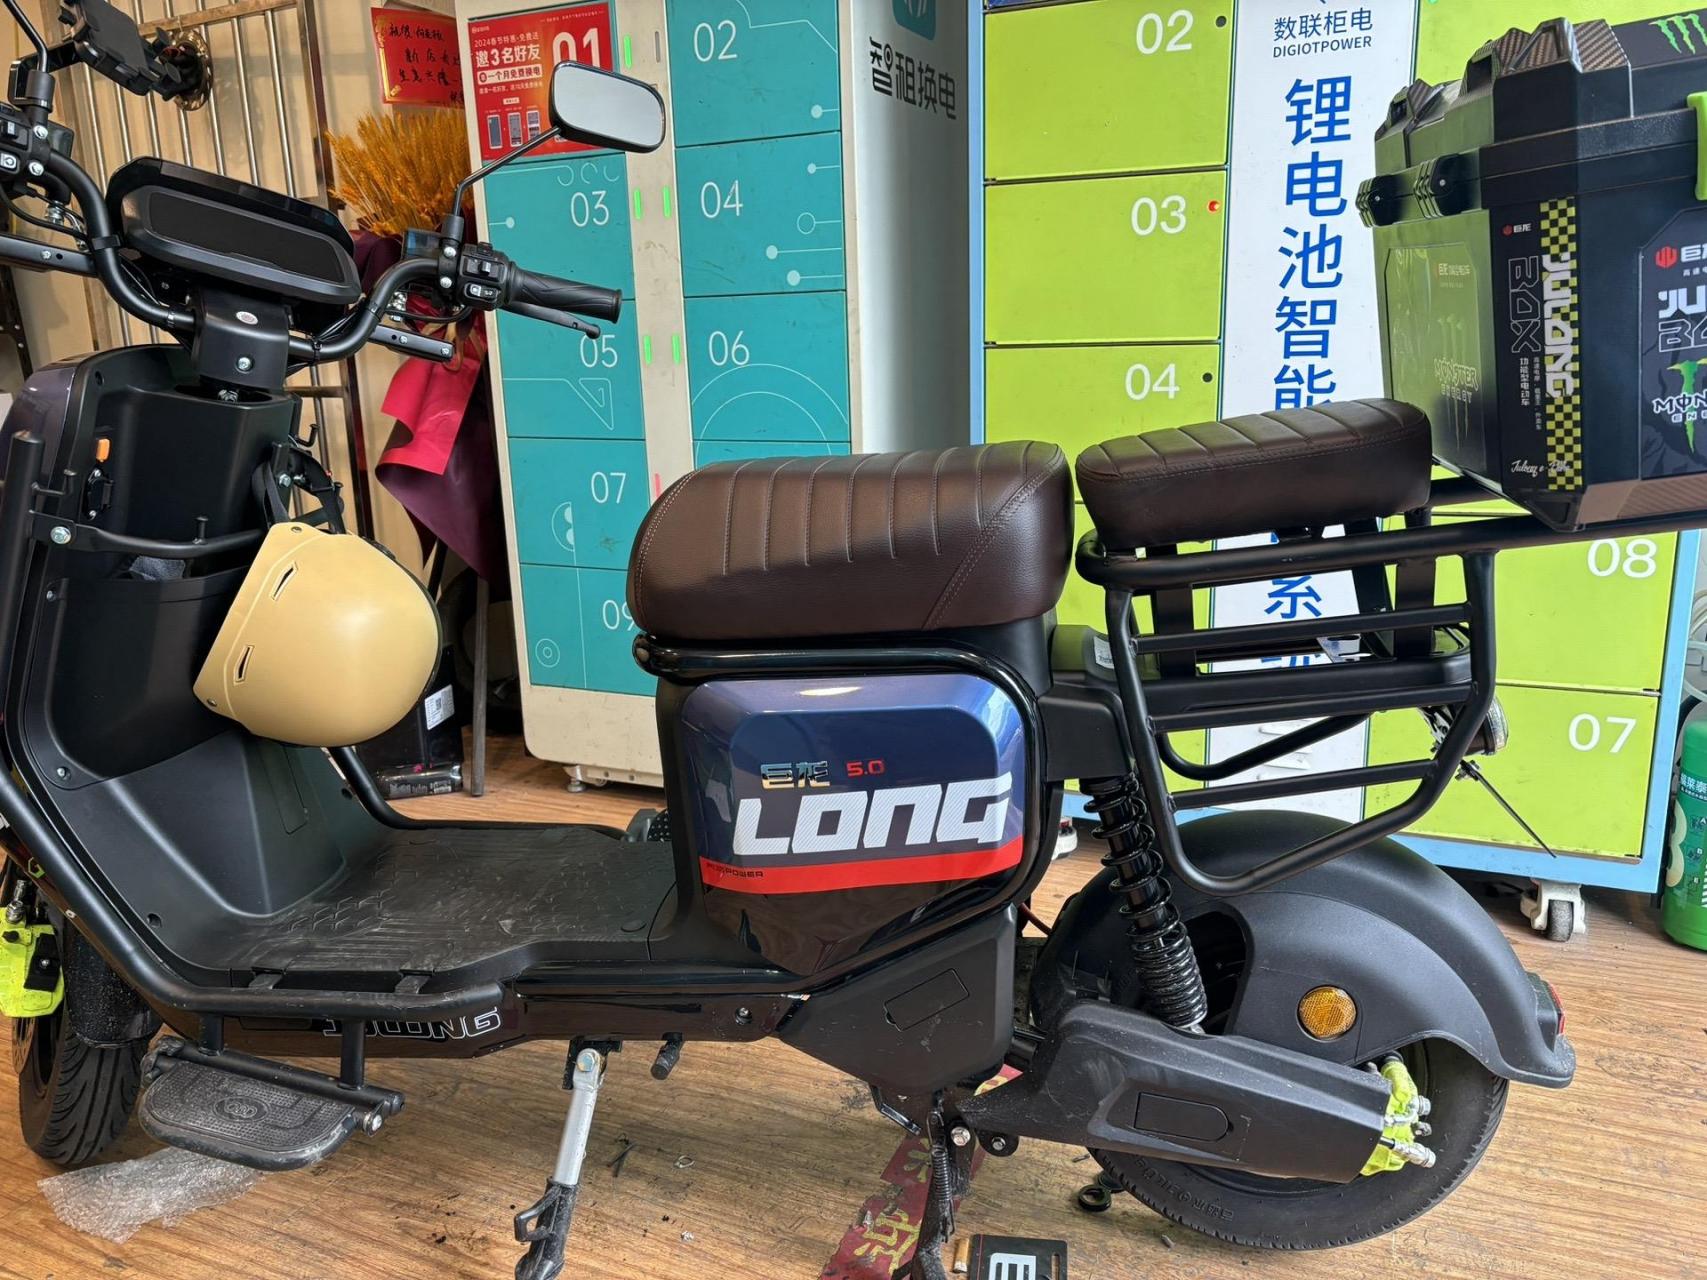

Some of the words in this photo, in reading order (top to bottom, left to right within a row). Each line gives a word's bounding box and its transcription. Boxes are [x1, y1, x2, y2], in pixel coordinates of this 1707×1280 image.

[693, 20, 738, 62] 02
[1136, 10, 1194, 54] 02
[1273, 8, 1373, 42] 数联柜电
[476, 44, 541, 68] 邀3名好友
[1273, 36, 1372, 58] DIGIOTPOWER
[869, 36, 957, 120] 智租换电
[571, 190, 609, 227] 03
[700, 179, 744, 218] 04
[1131, 195, 1187, 236] 03
[1681, 243, 1707, 263] 巨
[579, 334, 618, 368] 05
[708, 330, 749, 365] 06
[1125, 363, 1180, 400] 04
[591, 471, 626, 504] 07
[1587, 538, 1657, 578] 08
[602, 599, 635, 631] 09
[1568, 713, 1637, 753] 07
[846, 759, 886, 778] 5.0
[732, 772, 1012, 855] LONG
